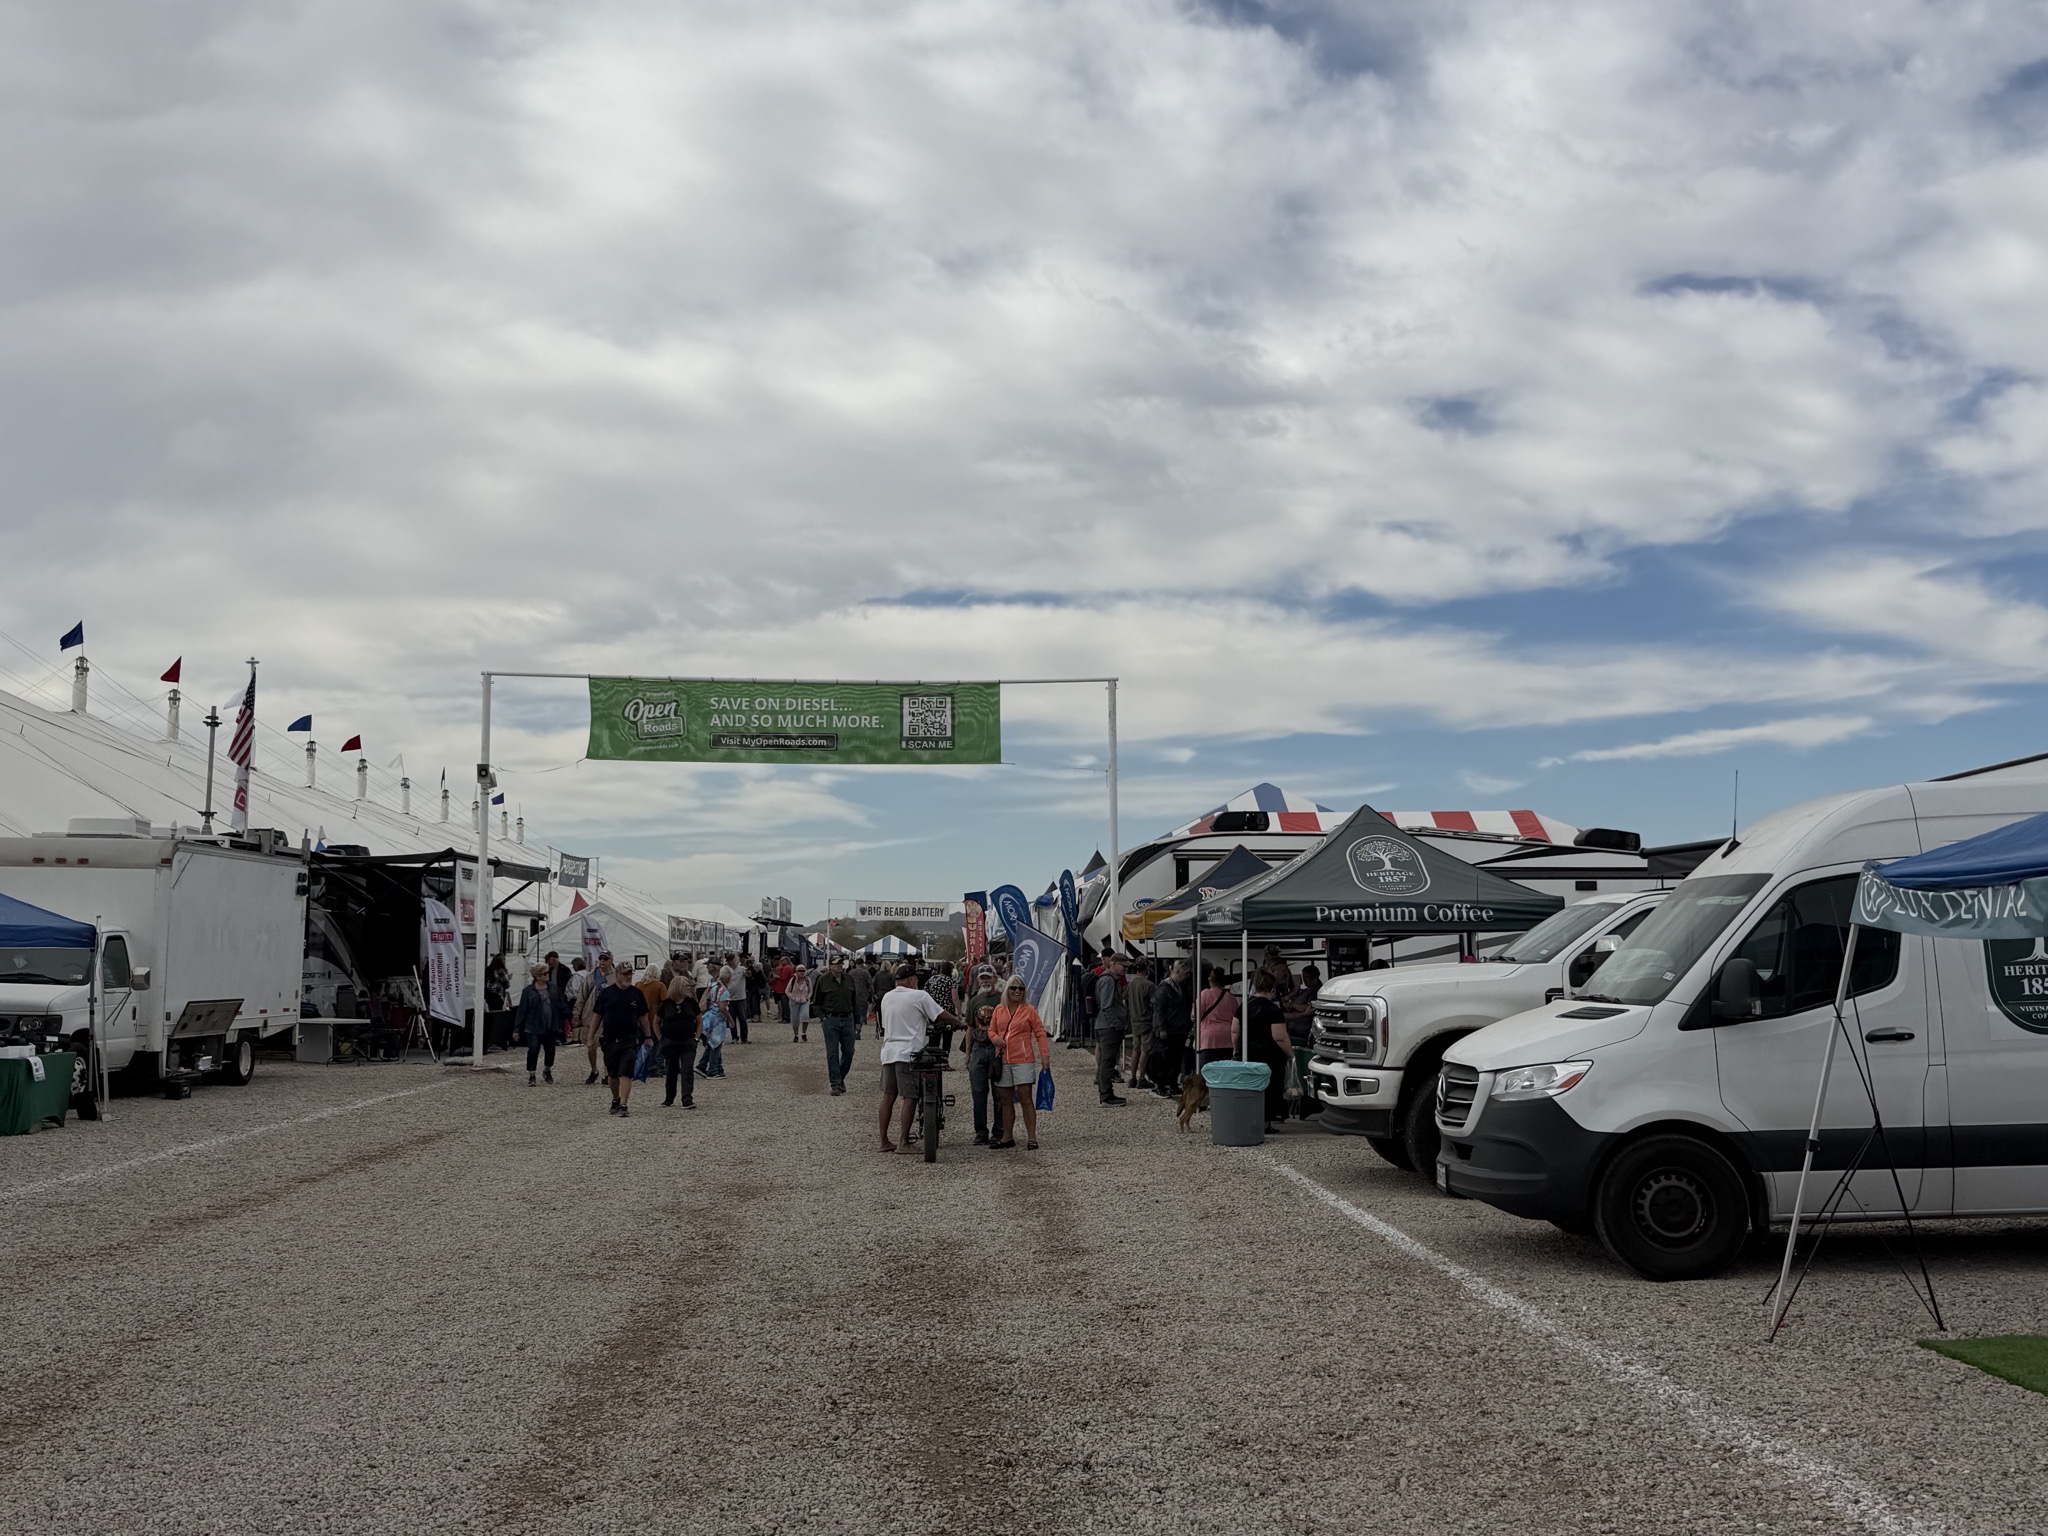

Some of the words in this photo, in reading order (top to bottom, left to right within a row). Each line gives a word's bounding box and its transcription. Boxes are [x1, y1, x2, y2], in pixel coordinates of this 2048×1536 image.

[710, 697, 750, 711] SAVE
[755, 698, 780, 711] ON
[786, 698, 852, 711] DIESEL...
[624, 699, 678, 724] Open
[644, 721, 678, 733] Roads
[710, 714, 746, 727] AND
[751, 714, 772, 728] SO
[778, 714, 827, 728] MUCH
[832, 715, 884, 728] MORE.
[721, 737, 741, 745] Visit
[742, 737, 827, 747] MyOpenRoads.com
[908, 740, 936, 749] SCAN
[938, 740, 953, 749] ME
[1890, 886, 1940, 921] LUX
[1942, 883, 2027, 921] DENTAL
[867, 906, 882, 916] BIG
[884, 906, 910, 917] BEARD
[911, 907, 945, 917] BATTERY
[1315, 902, 1418, 922] Premium
[1423, 903, 1494, 922] Coffee
